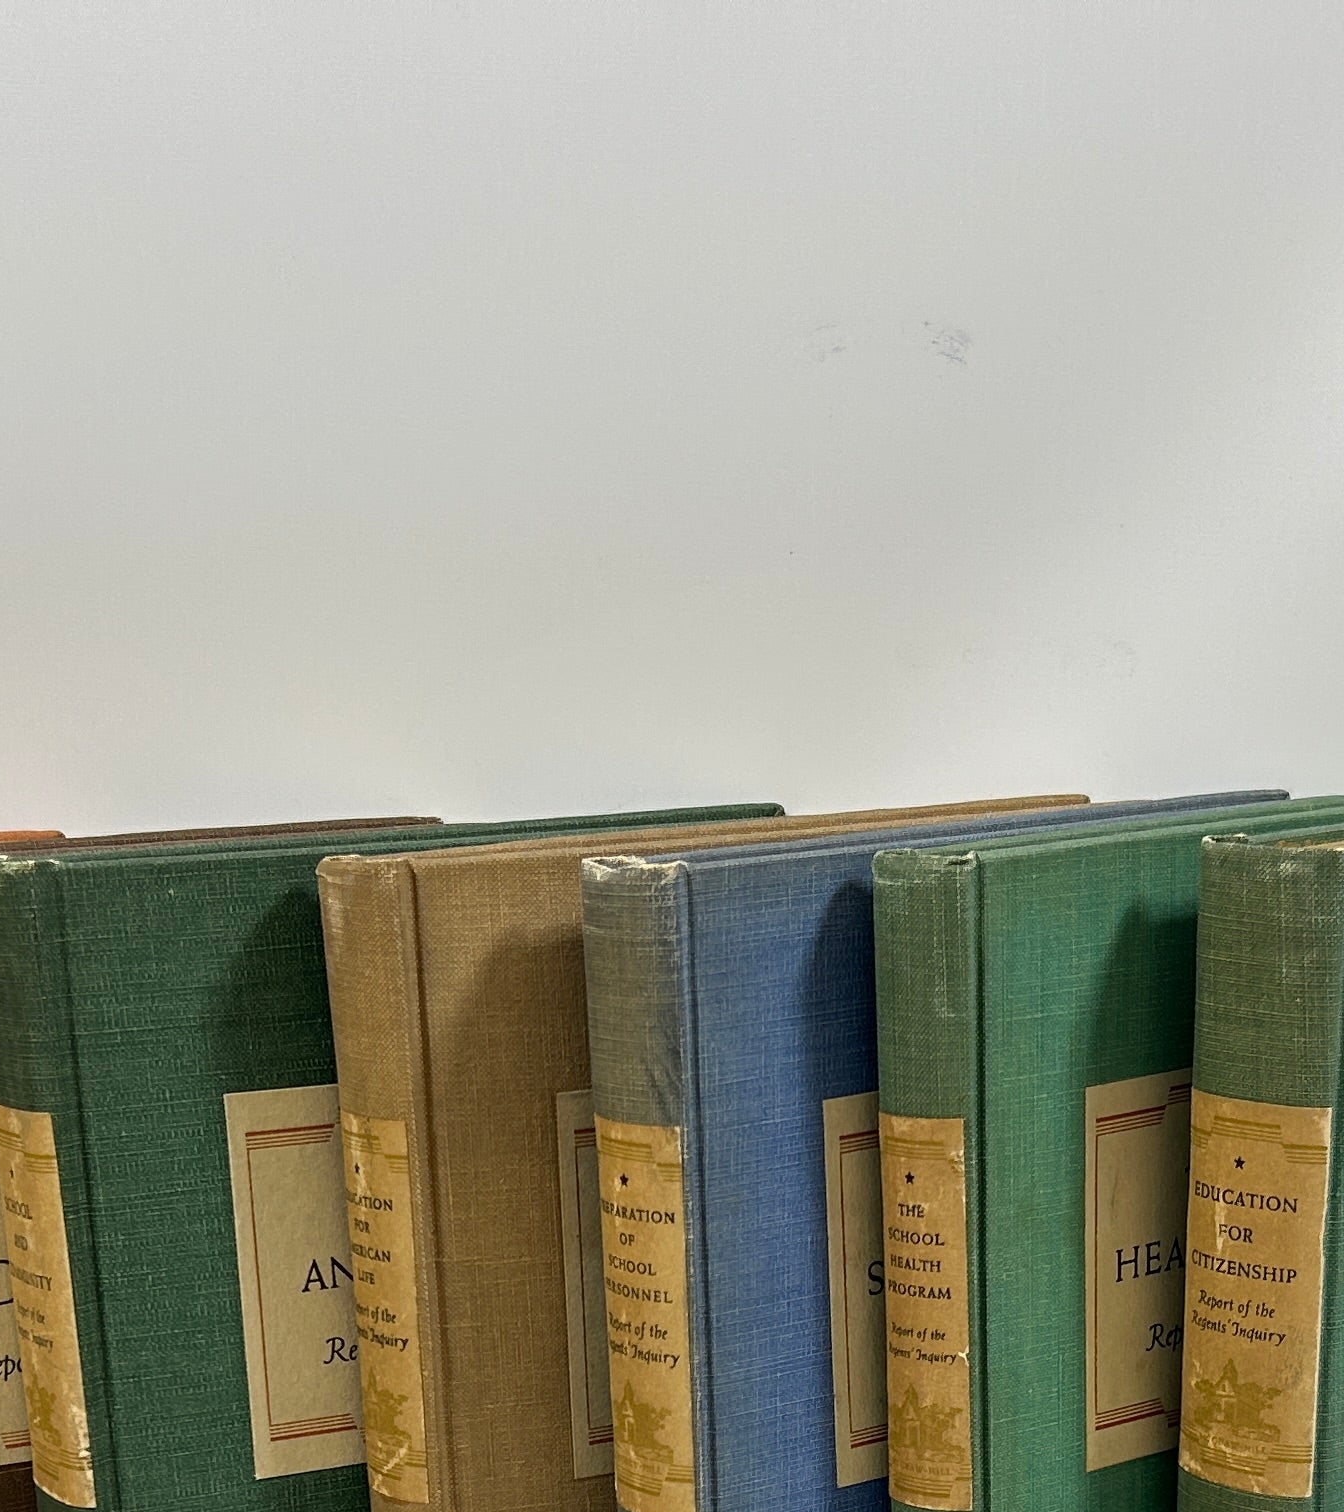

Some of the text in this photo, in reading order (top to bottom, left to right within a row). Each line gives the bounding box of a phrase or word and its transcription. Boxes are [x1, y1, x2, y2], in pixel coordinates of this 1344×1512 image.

[1194, 1180, 1298, 1214] EDUCATION
[898, 1203, 925, 1218] THE
[888, 1226, 945, 1247] SCHOOL
[1218, 1223, 1253, 1243] FOR
[608, 1253, 657, 1276] SCHOOL
[890, 1253, 941, 1273] HEALTH
[1115, 1236, 1185, 1283] HEA
[1191, 1249, 1297, 1284] CITIZENSHIP
[358, 1268, 375, 1285] LIFE
[887, 1281, 952, 1300] PROGRAM
[1198, 1289, 1275, 1318] Report of the
[382, 1308, 396, 1324] the
[634, 1319, 647, 1341] of
[649, 1323, 668, 1341] the
[916, 1326, 928, 1342] of
[930, 1328, 946, 1342] the
[1191, 1309, 1286, 1346] Regents' Inquiry
[632, 1343, 680, 1369] Inquiry
[916, 1348, 956, 1366] Inquiry
